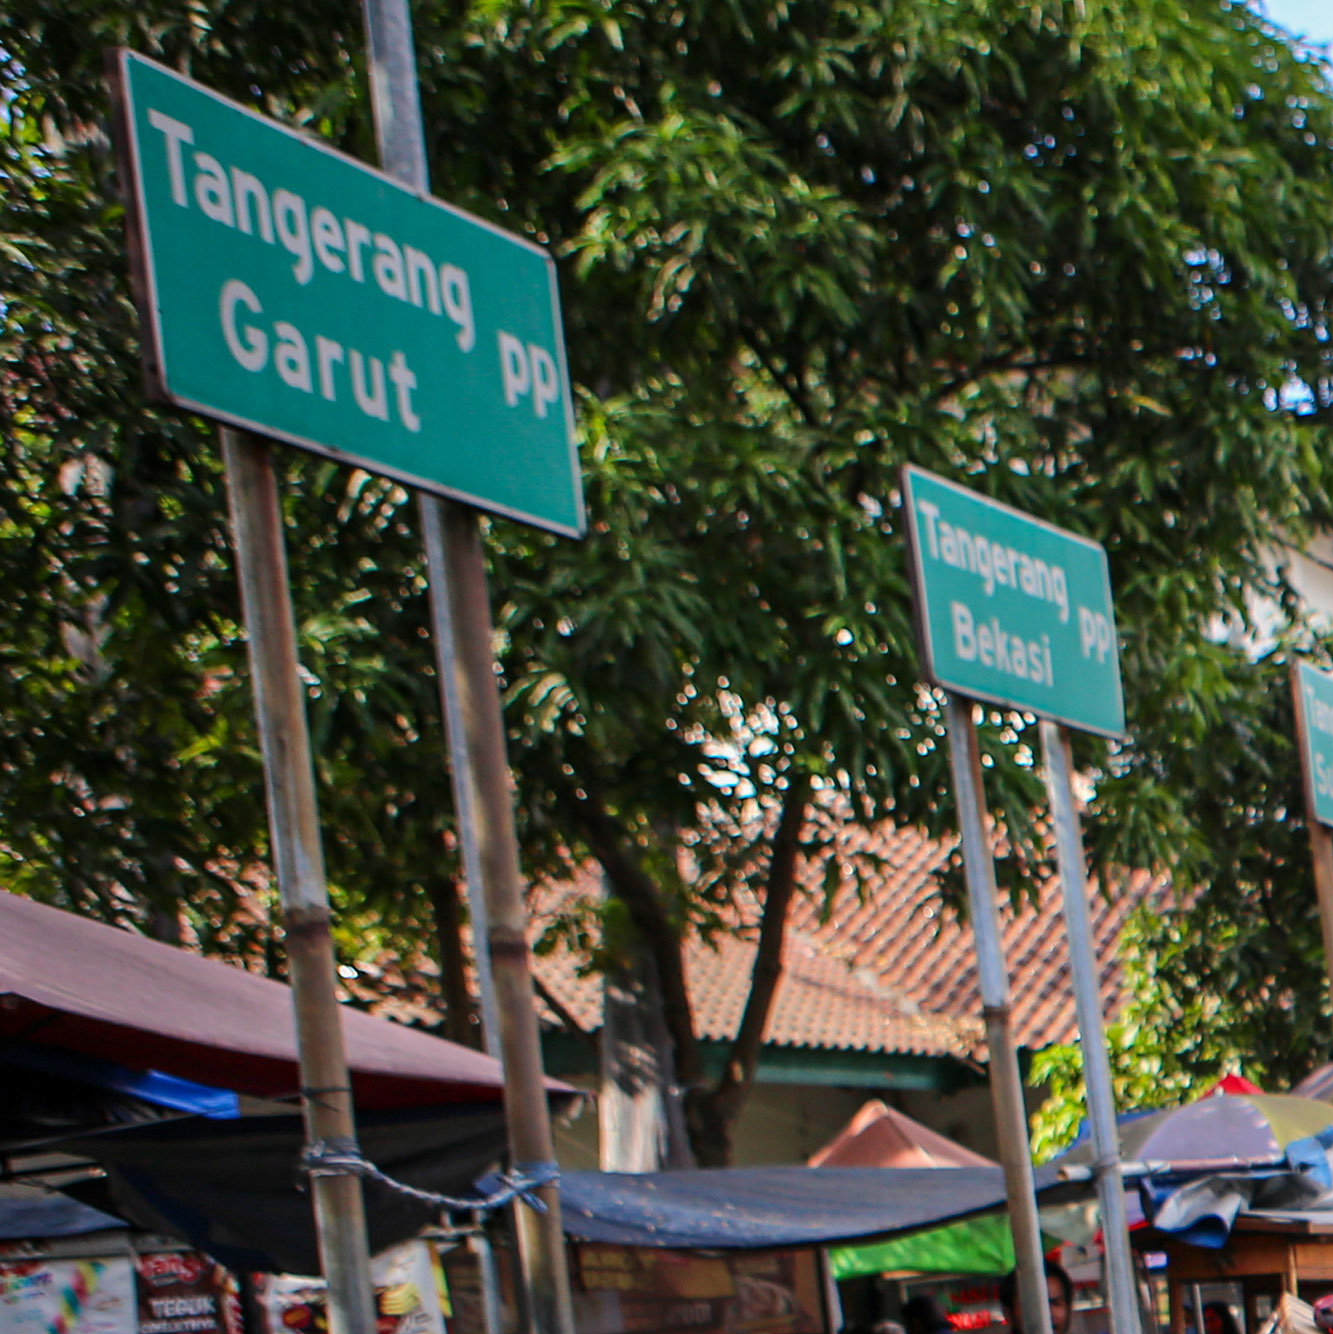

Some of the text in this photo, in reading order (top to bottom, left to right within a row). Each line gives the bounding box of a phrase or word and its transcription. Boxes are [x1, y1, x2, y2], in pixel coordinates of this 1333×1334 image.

[147, 107, 560, 419] Tangerang pp
[219, 279, 421, 433] Garut
[919, 500, 1113, 664] Tangerang pp
[951, 601, 1054, 688] Bekasi
